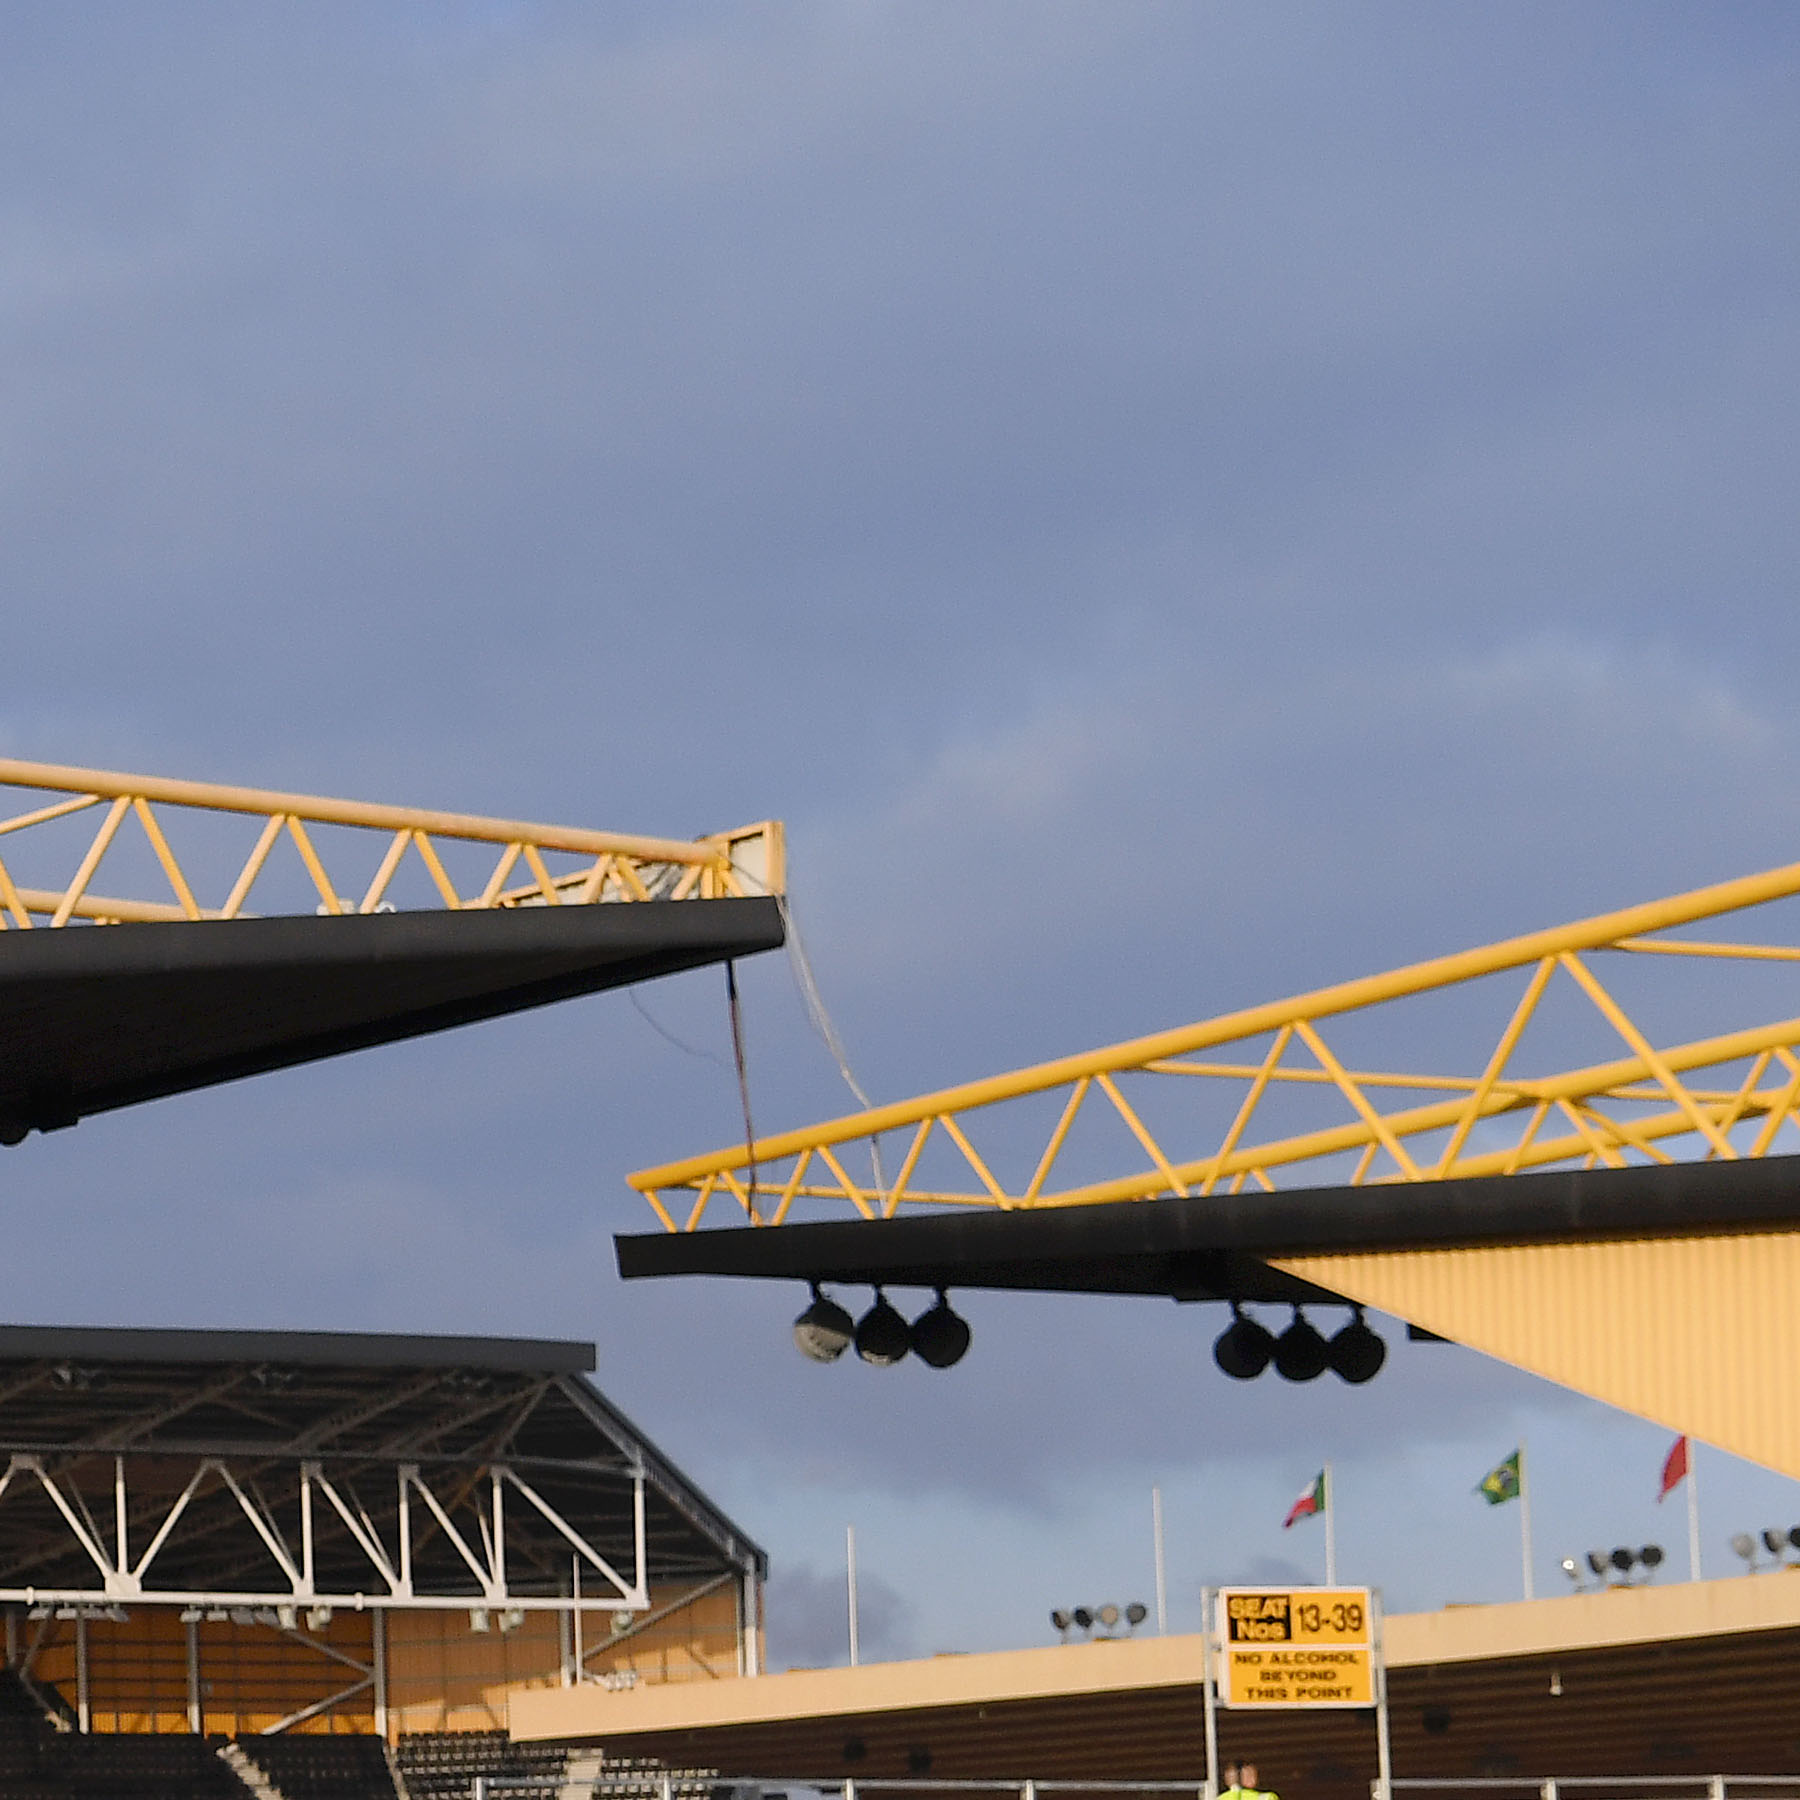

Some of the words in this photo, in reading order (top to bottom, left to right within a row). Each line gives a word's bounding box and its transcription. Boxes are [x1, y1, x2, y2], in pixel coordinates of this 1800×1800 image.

[1228, 1596, 1288, 1618] SEAT
[1296, 1604, 1363, 1632] 13-39
[1234, 1652, 1262, 1665] NO
[1269, 1652, 1359, 1665] ALCOHOL
[1259, 1669, 1337, 1682] BEYOND
[1246, 1687, 1288, 1700] THIS
[1295, 1687, 1353, 1700] POINT
